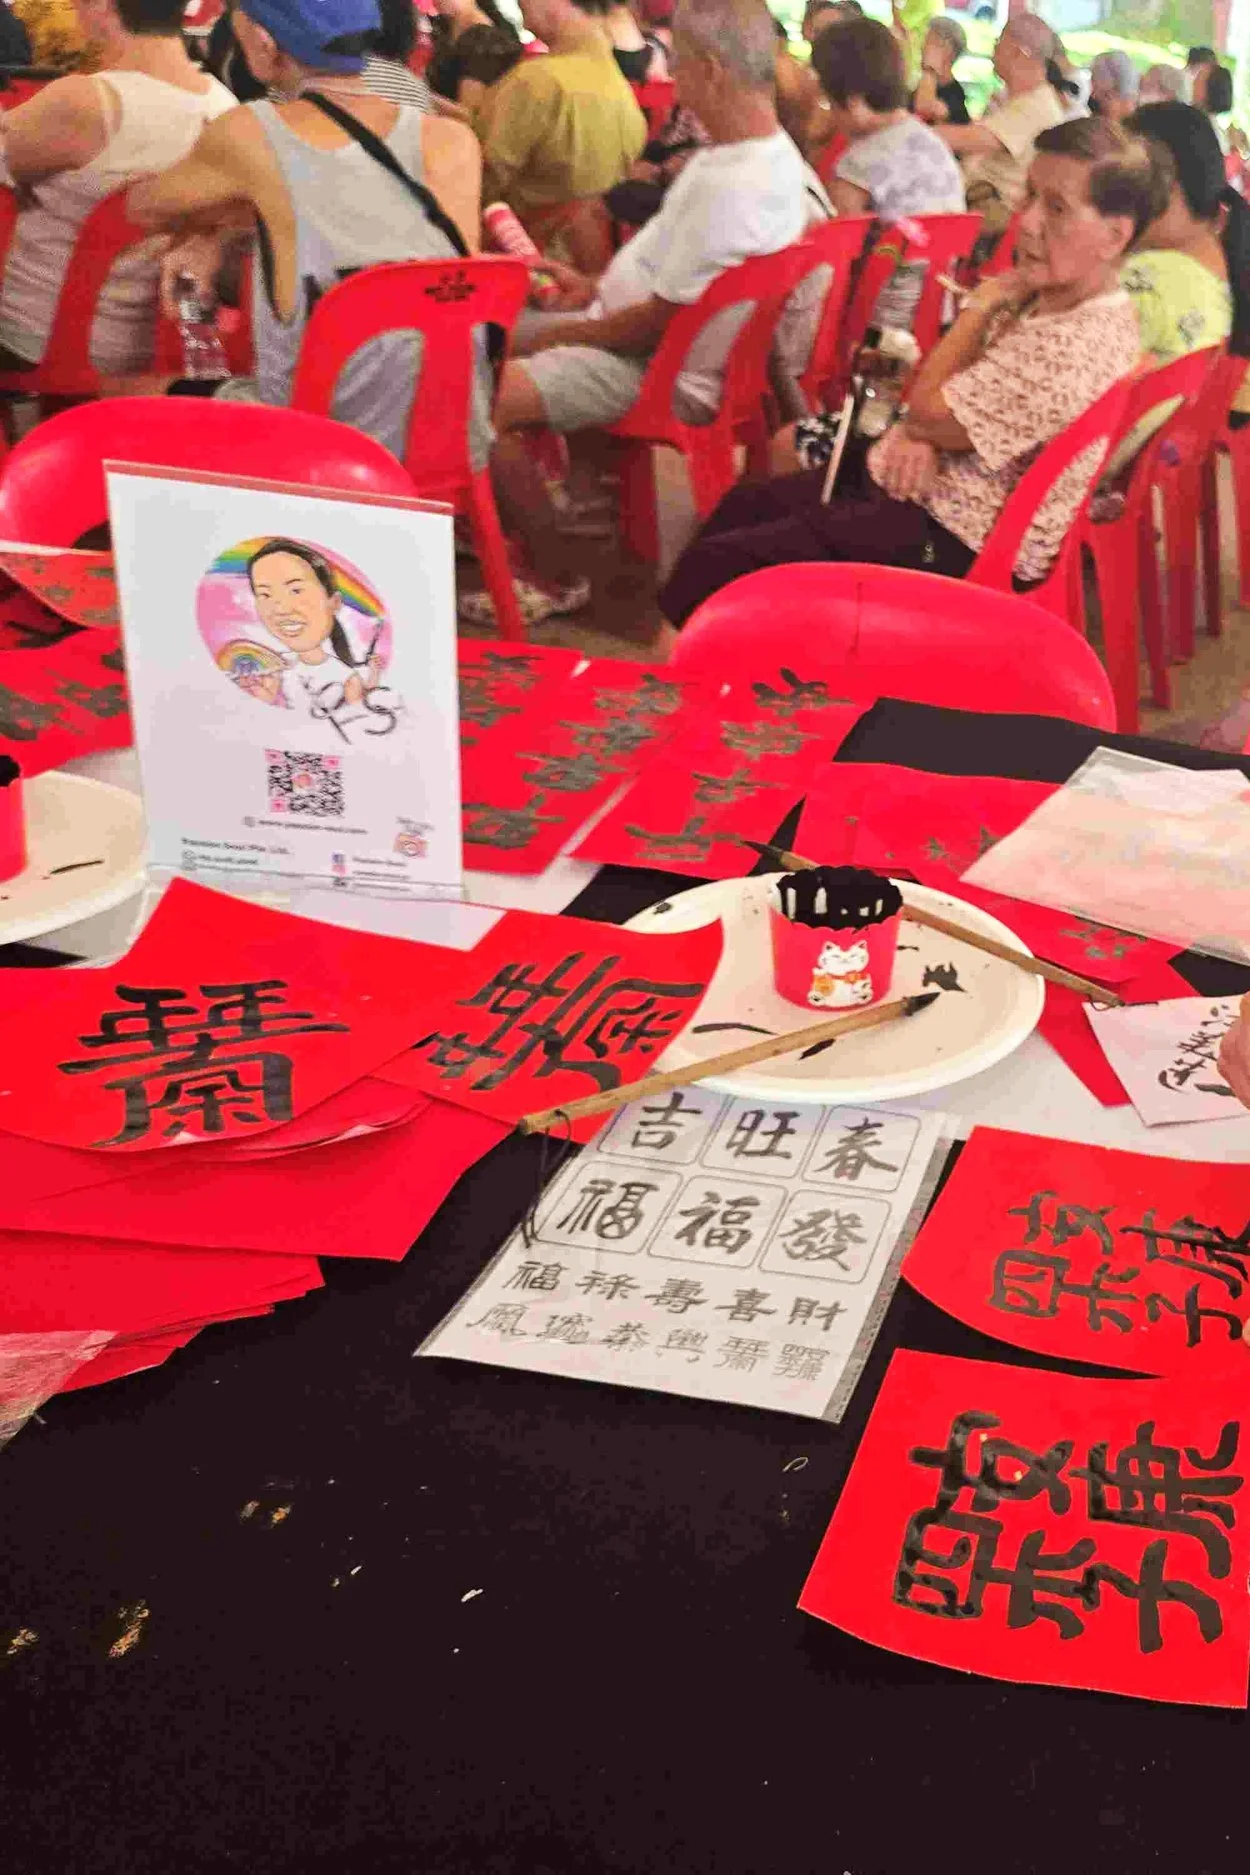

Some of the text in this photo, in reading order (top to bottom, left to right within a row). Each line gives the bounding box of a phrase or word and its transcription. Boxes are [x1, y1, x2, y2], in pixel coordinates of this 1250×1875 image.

[631, 1091, 900, 1182] 吉 旺 春
[556, 1177, 659, 1240] 福
[673, 1191, 760, 1255] 福
